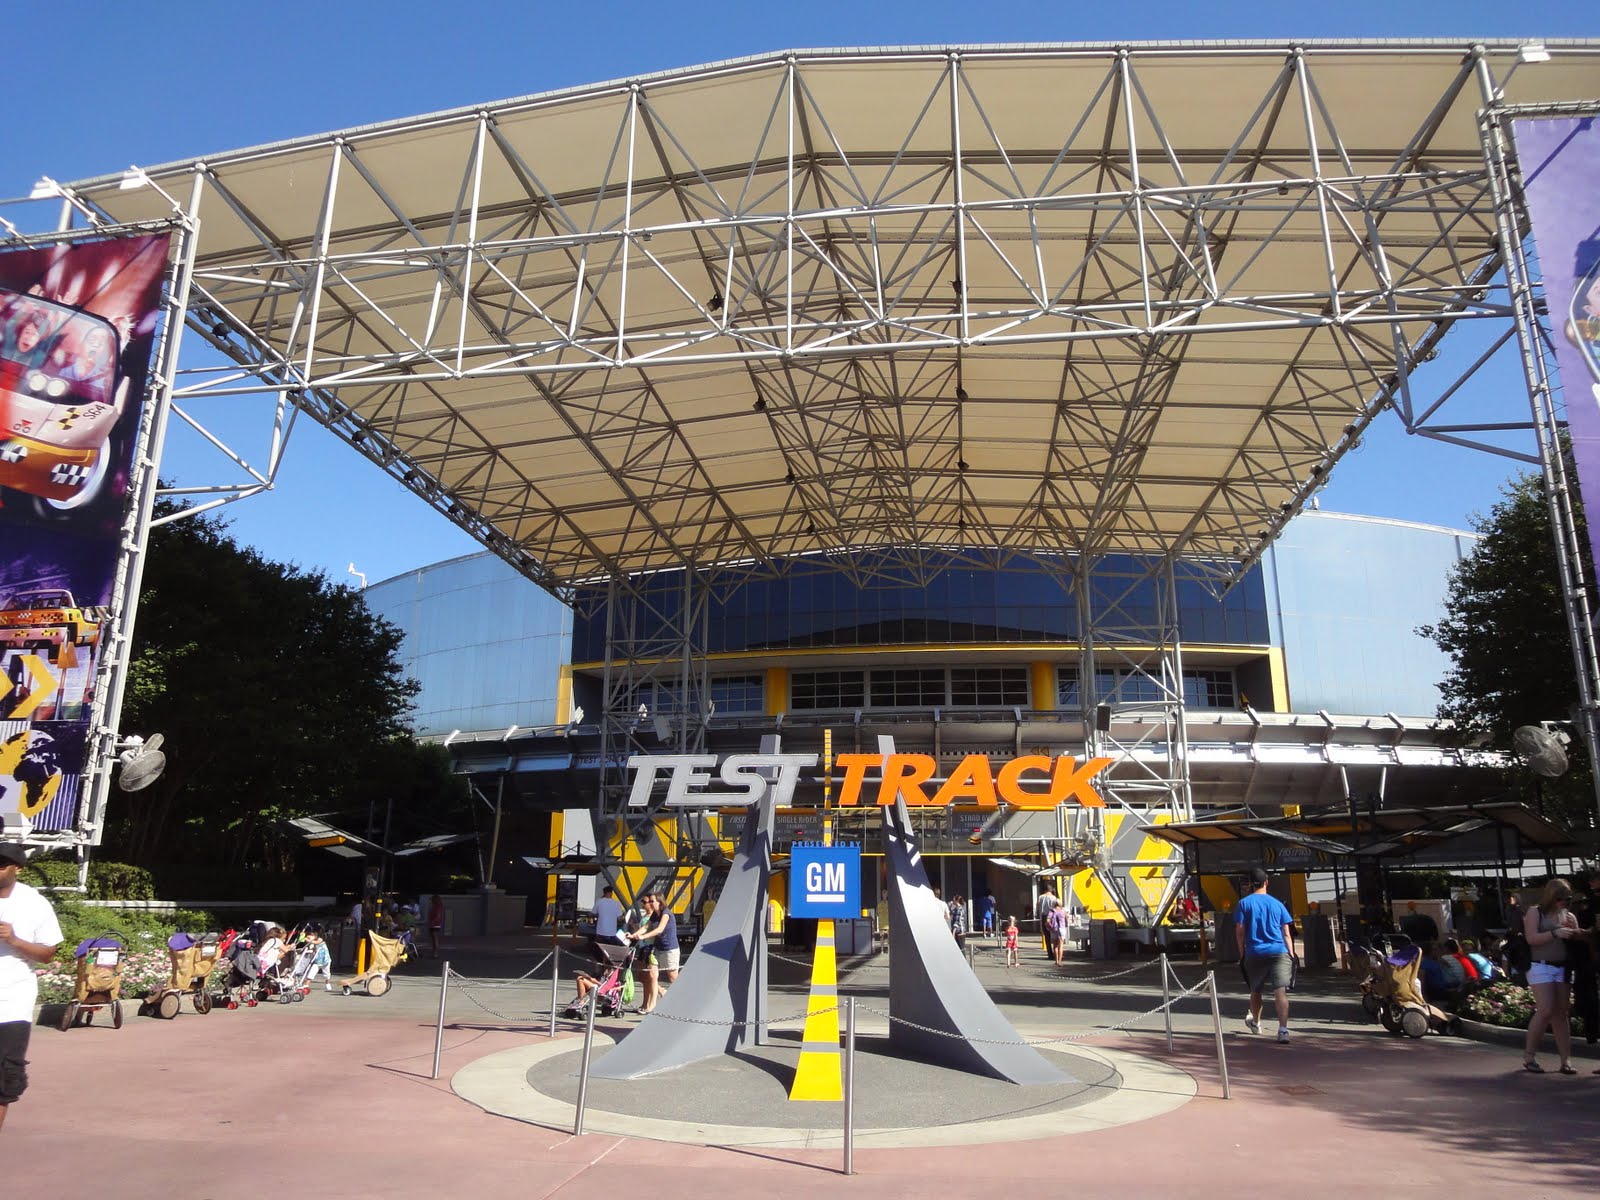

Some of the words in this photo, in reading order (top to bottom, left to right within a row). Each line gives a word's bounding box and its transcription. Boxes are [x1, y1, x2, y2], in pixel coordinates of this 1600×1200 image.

[627, 753, 819, 807] TEST
[836, 753, 1115, 808] TRACK
[776, 816, 797, 824] SINGLE
[799, 816, 818, 824] RIDER
[960, 814, 980, 822] STAND
[792, 840, 846, 848] PRESENTED
[849, 840, 861, 848] BY
[806, 862, 846, 892] GM
